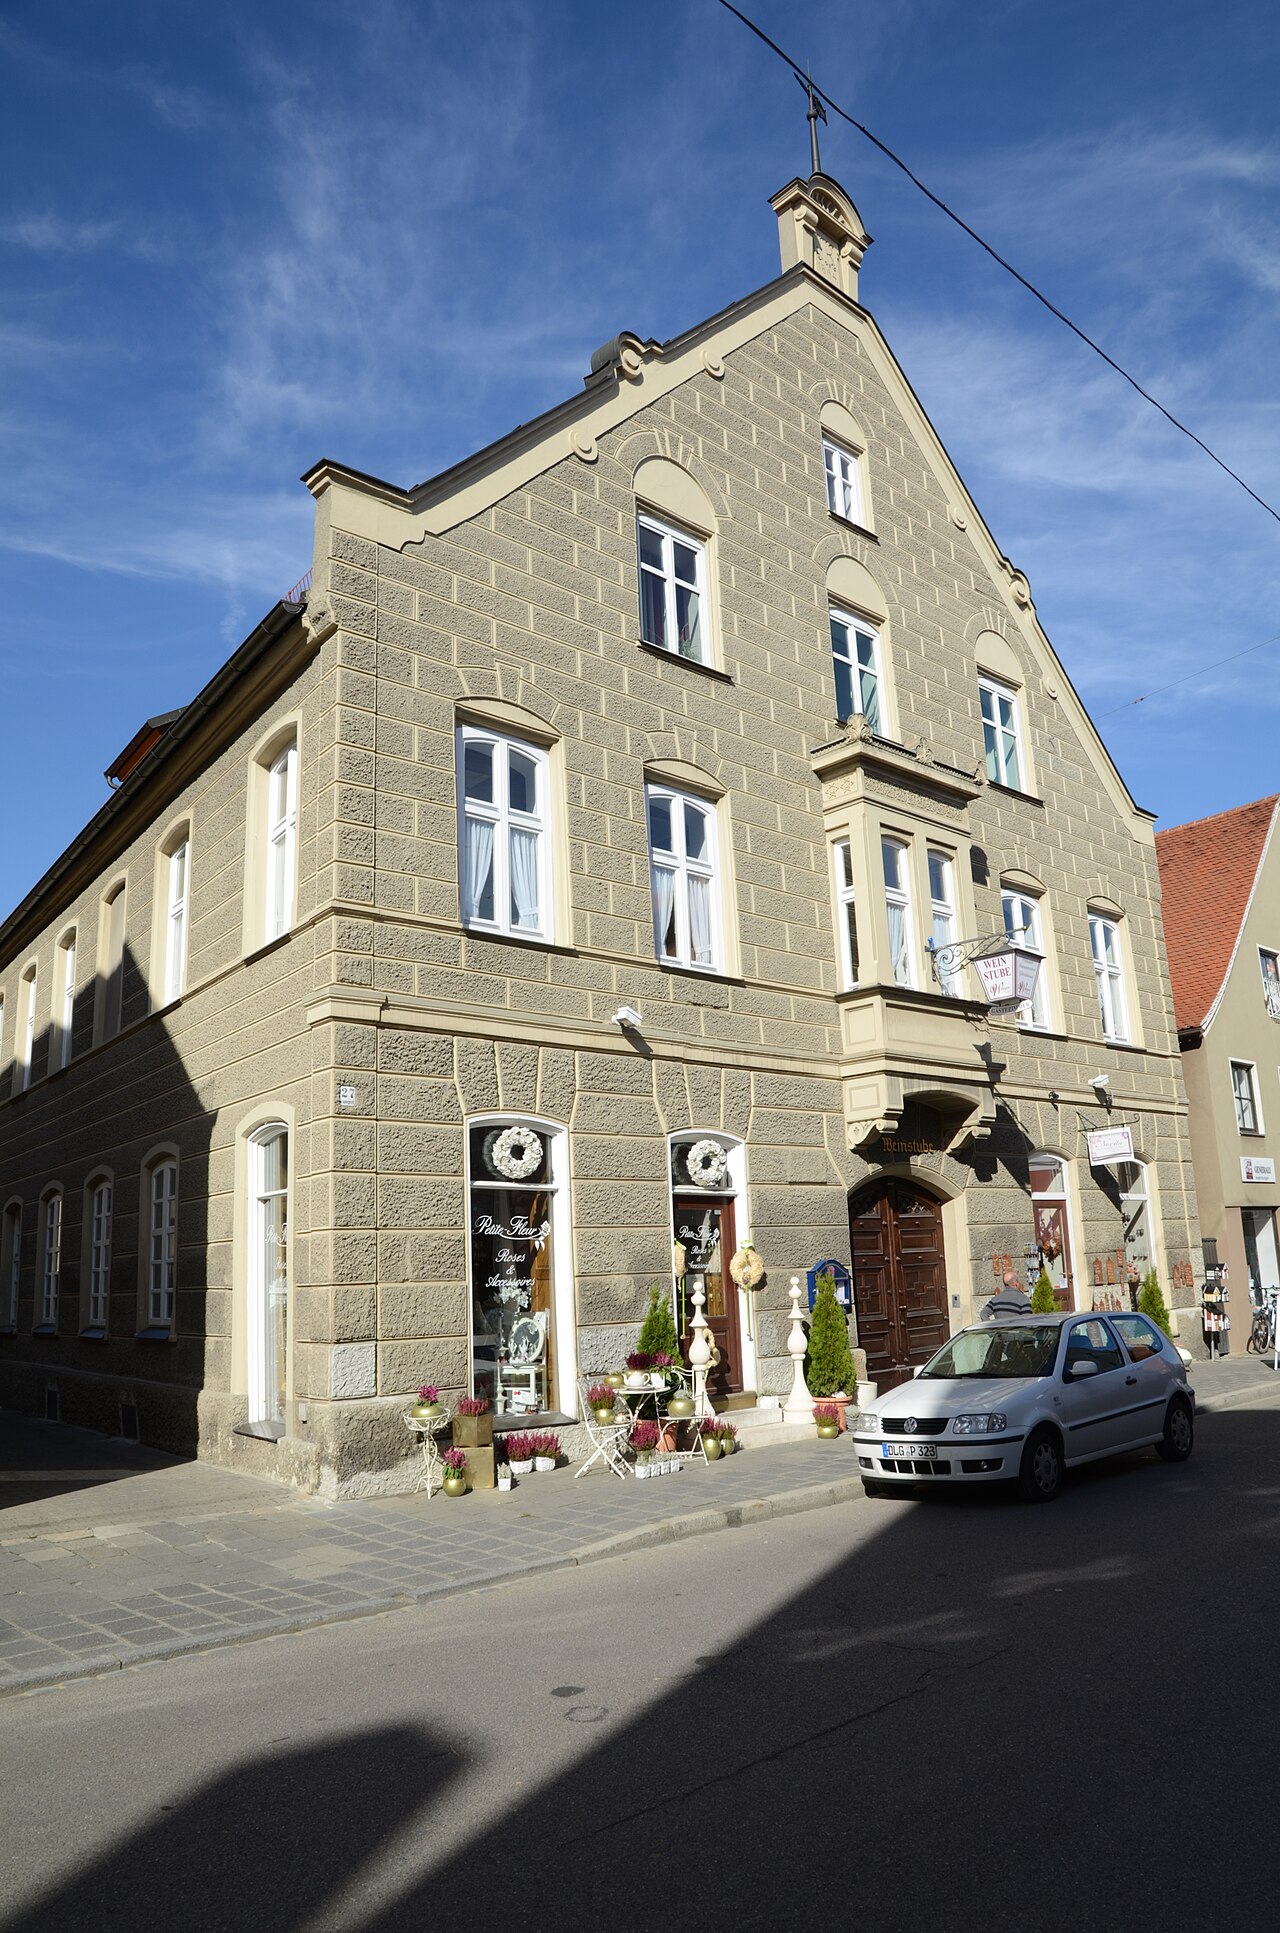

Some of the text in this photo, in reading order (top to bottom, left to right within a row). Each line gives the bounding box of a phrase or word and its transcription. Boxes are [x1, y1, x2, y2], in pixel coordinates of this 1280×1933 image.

[983, 956, 1007, 969] WEIN
[983, 967, 1011, 981] STUBE
[341, 1087, 355, 1099] 27
[882, 1136, 934, 1153] Weinstube
[495, 1249, 526, 1262] Roses
[506, 1265, 516, 1275] &
[485, 1273, 536, 1287] Accessoires
[887, 1445, 905, 1456] DLG
[910, 1446, 916, 1456] P
[918, 1446, 936, 1457] 323
